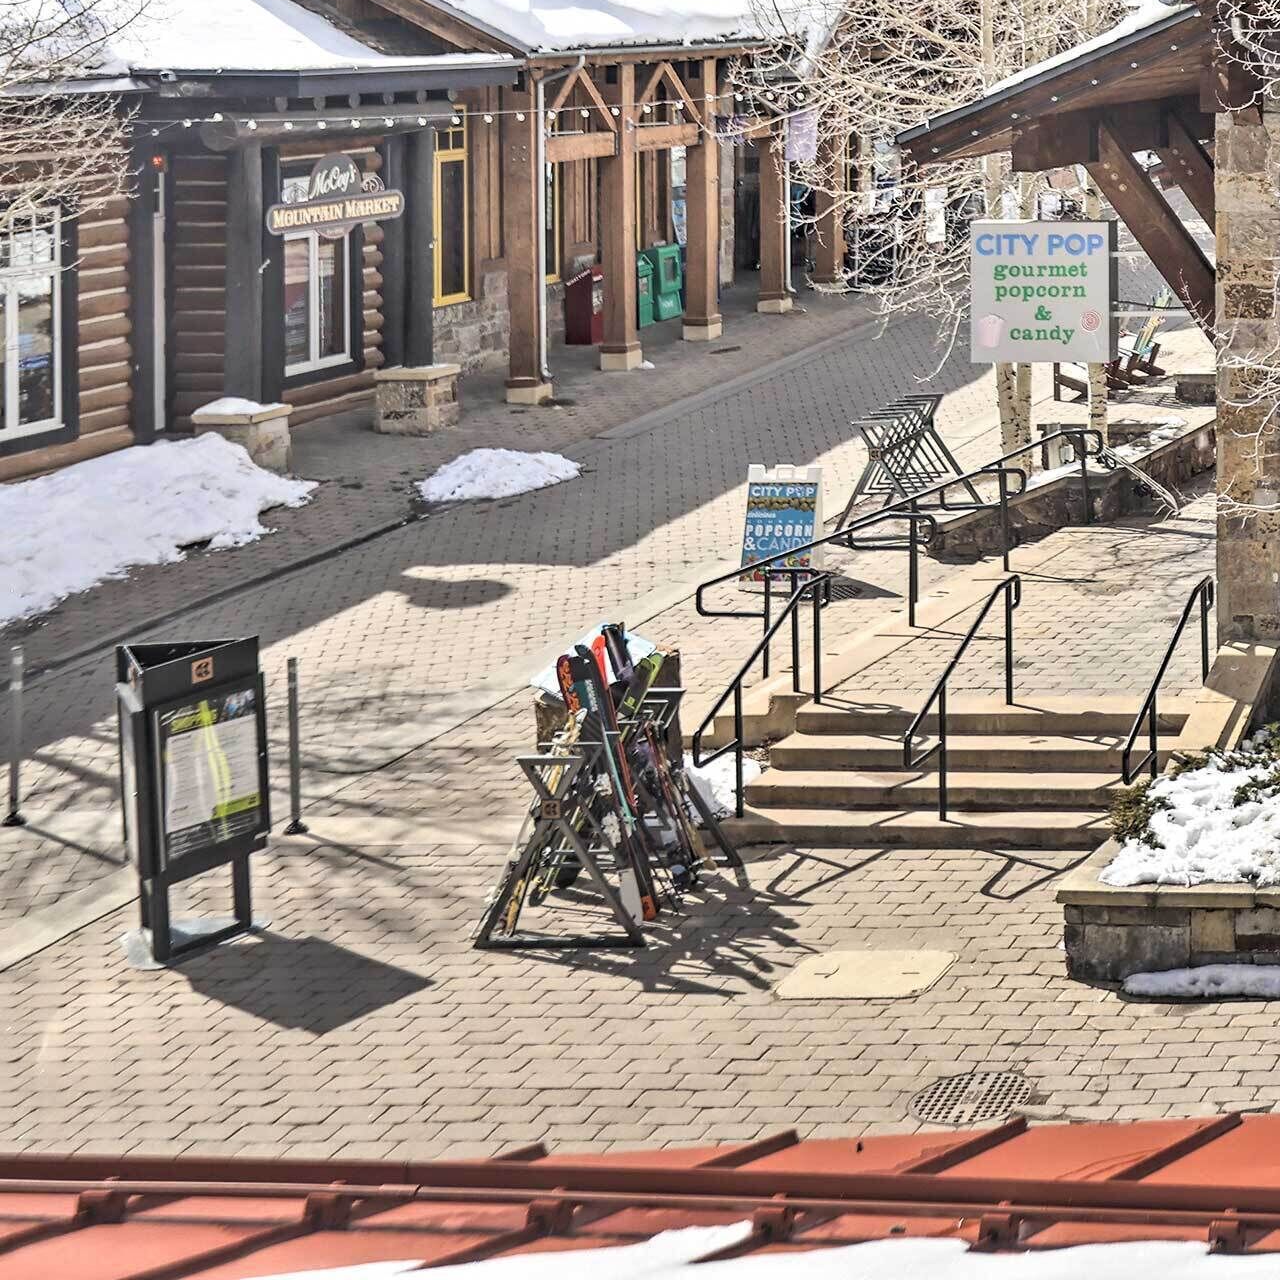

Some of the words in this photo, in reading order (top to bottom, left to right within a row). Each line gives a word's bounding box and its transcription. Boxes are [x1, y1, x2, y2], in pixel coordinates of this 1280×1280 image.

[308, 163, 357, 200] McCoy's
[272, 203, 343, 228] MOUNTAIN
[345, 196, 400, 218] MARKET
[976, 233, 1039, 256] CITY
[1047, 233, 1104, 256] POP
[993, 261, 1088, 281] gourmet
[994, 285, 1087, 302] popcorn
[1034, 305, 1052, 321] &
[1009, 325, 1075, 345] candy
[751, 486, 783, 497] CITY
[786, 486, 815, 497] POP
[745, 524, 813, 537] POPCORN
